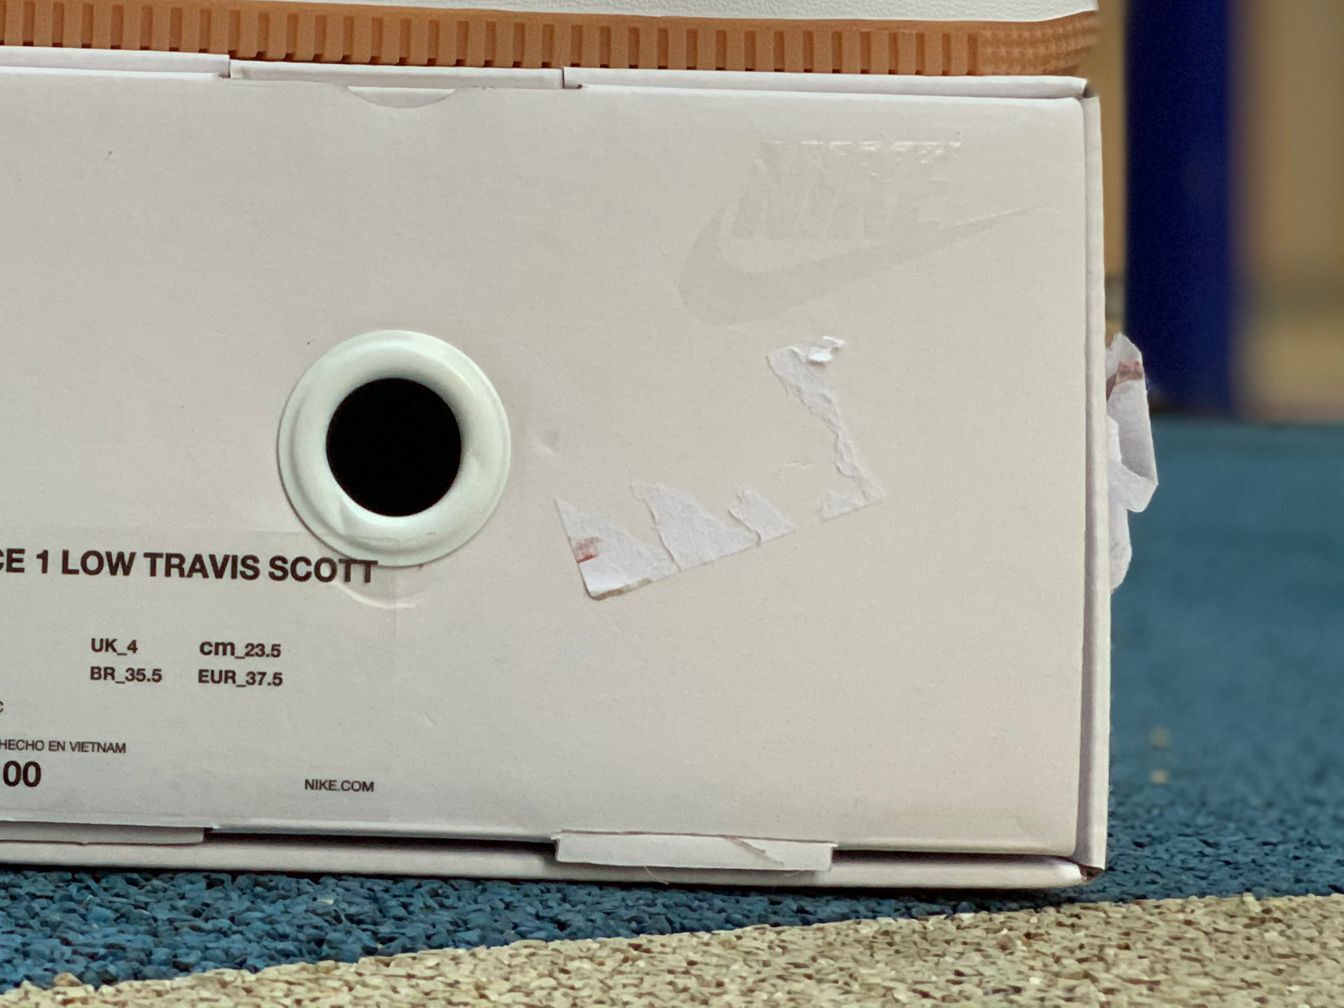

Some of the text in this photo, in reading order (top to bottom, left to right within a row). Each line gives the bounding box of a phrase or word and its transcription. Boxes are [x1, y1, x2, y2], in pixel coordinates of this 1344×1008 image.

[35, 549, 49, 574] 1
[61, 549, 137, 577] LOW
[142, 551, 261, 581] TRAVIS
[268, 555, 379, 584] SCOTT
[91, 637, 139, 656] UK_4
[199, 640, 282, 660] cm_23.5
[89, 665, 163, 685] BR_35.5
[197, 668, 284, 688] EUR_37.5
[48, 740, 66, 752] EN
[68, 740, 127, 754] VIETNAM
[304, 778, 375, 793] NIKE.COM
